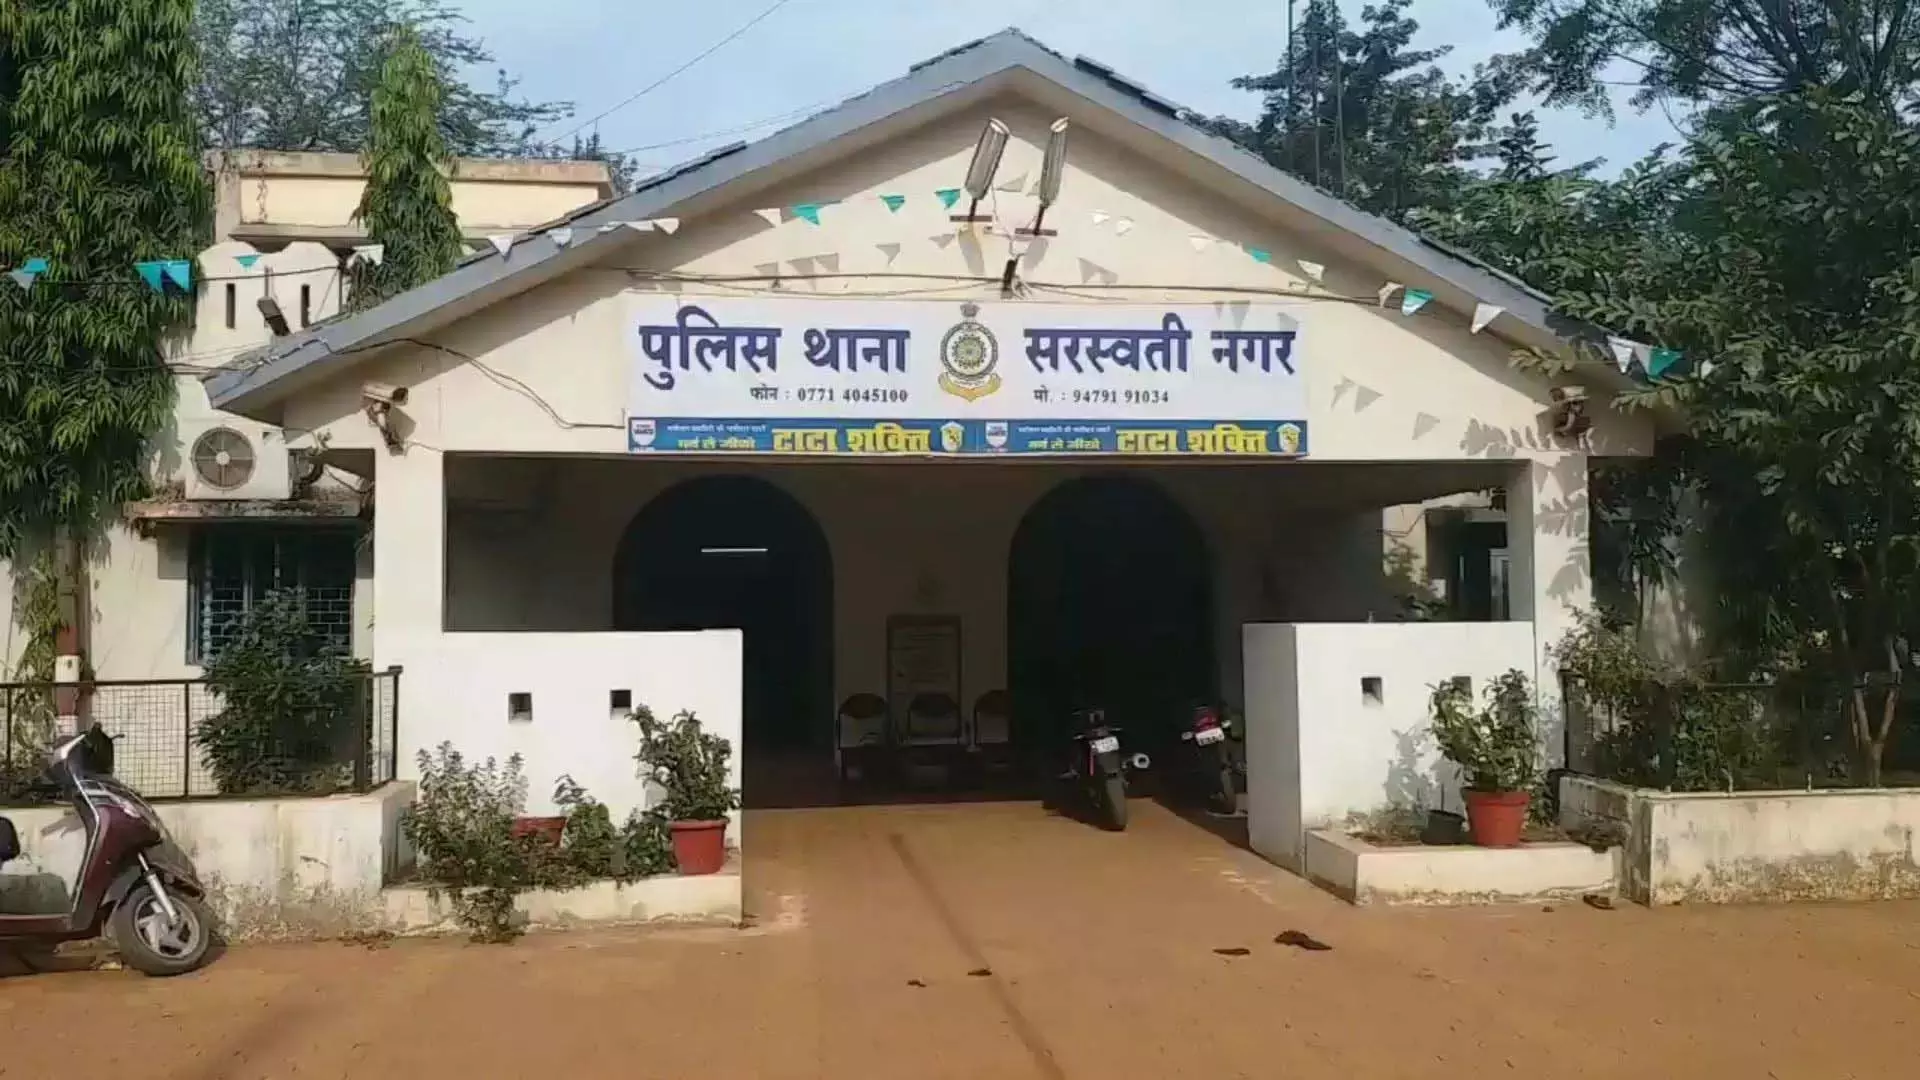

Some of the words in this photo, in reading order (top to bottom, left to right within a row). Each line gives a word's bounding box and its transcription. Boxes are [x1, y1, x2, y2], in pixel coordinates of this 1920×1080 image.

[639, 305, 782, 390] पुलिस
[803, 328, 911, 373] थाना
[1023, 312, 1192, 374] सरस्वती
[1210, 330, 1297, 375] नगर
[749, 383, 779, 401] फोन
[797, 387, 835, 402] 0771
[841, 388, 909, 403] 4045100
[1072, 389, 1118, 403] 94791
[1123, 389, 1169, 403] 91034
[772, 428, 838, 452] टाटा
[1115, 430, 1178, 453] टाटा
